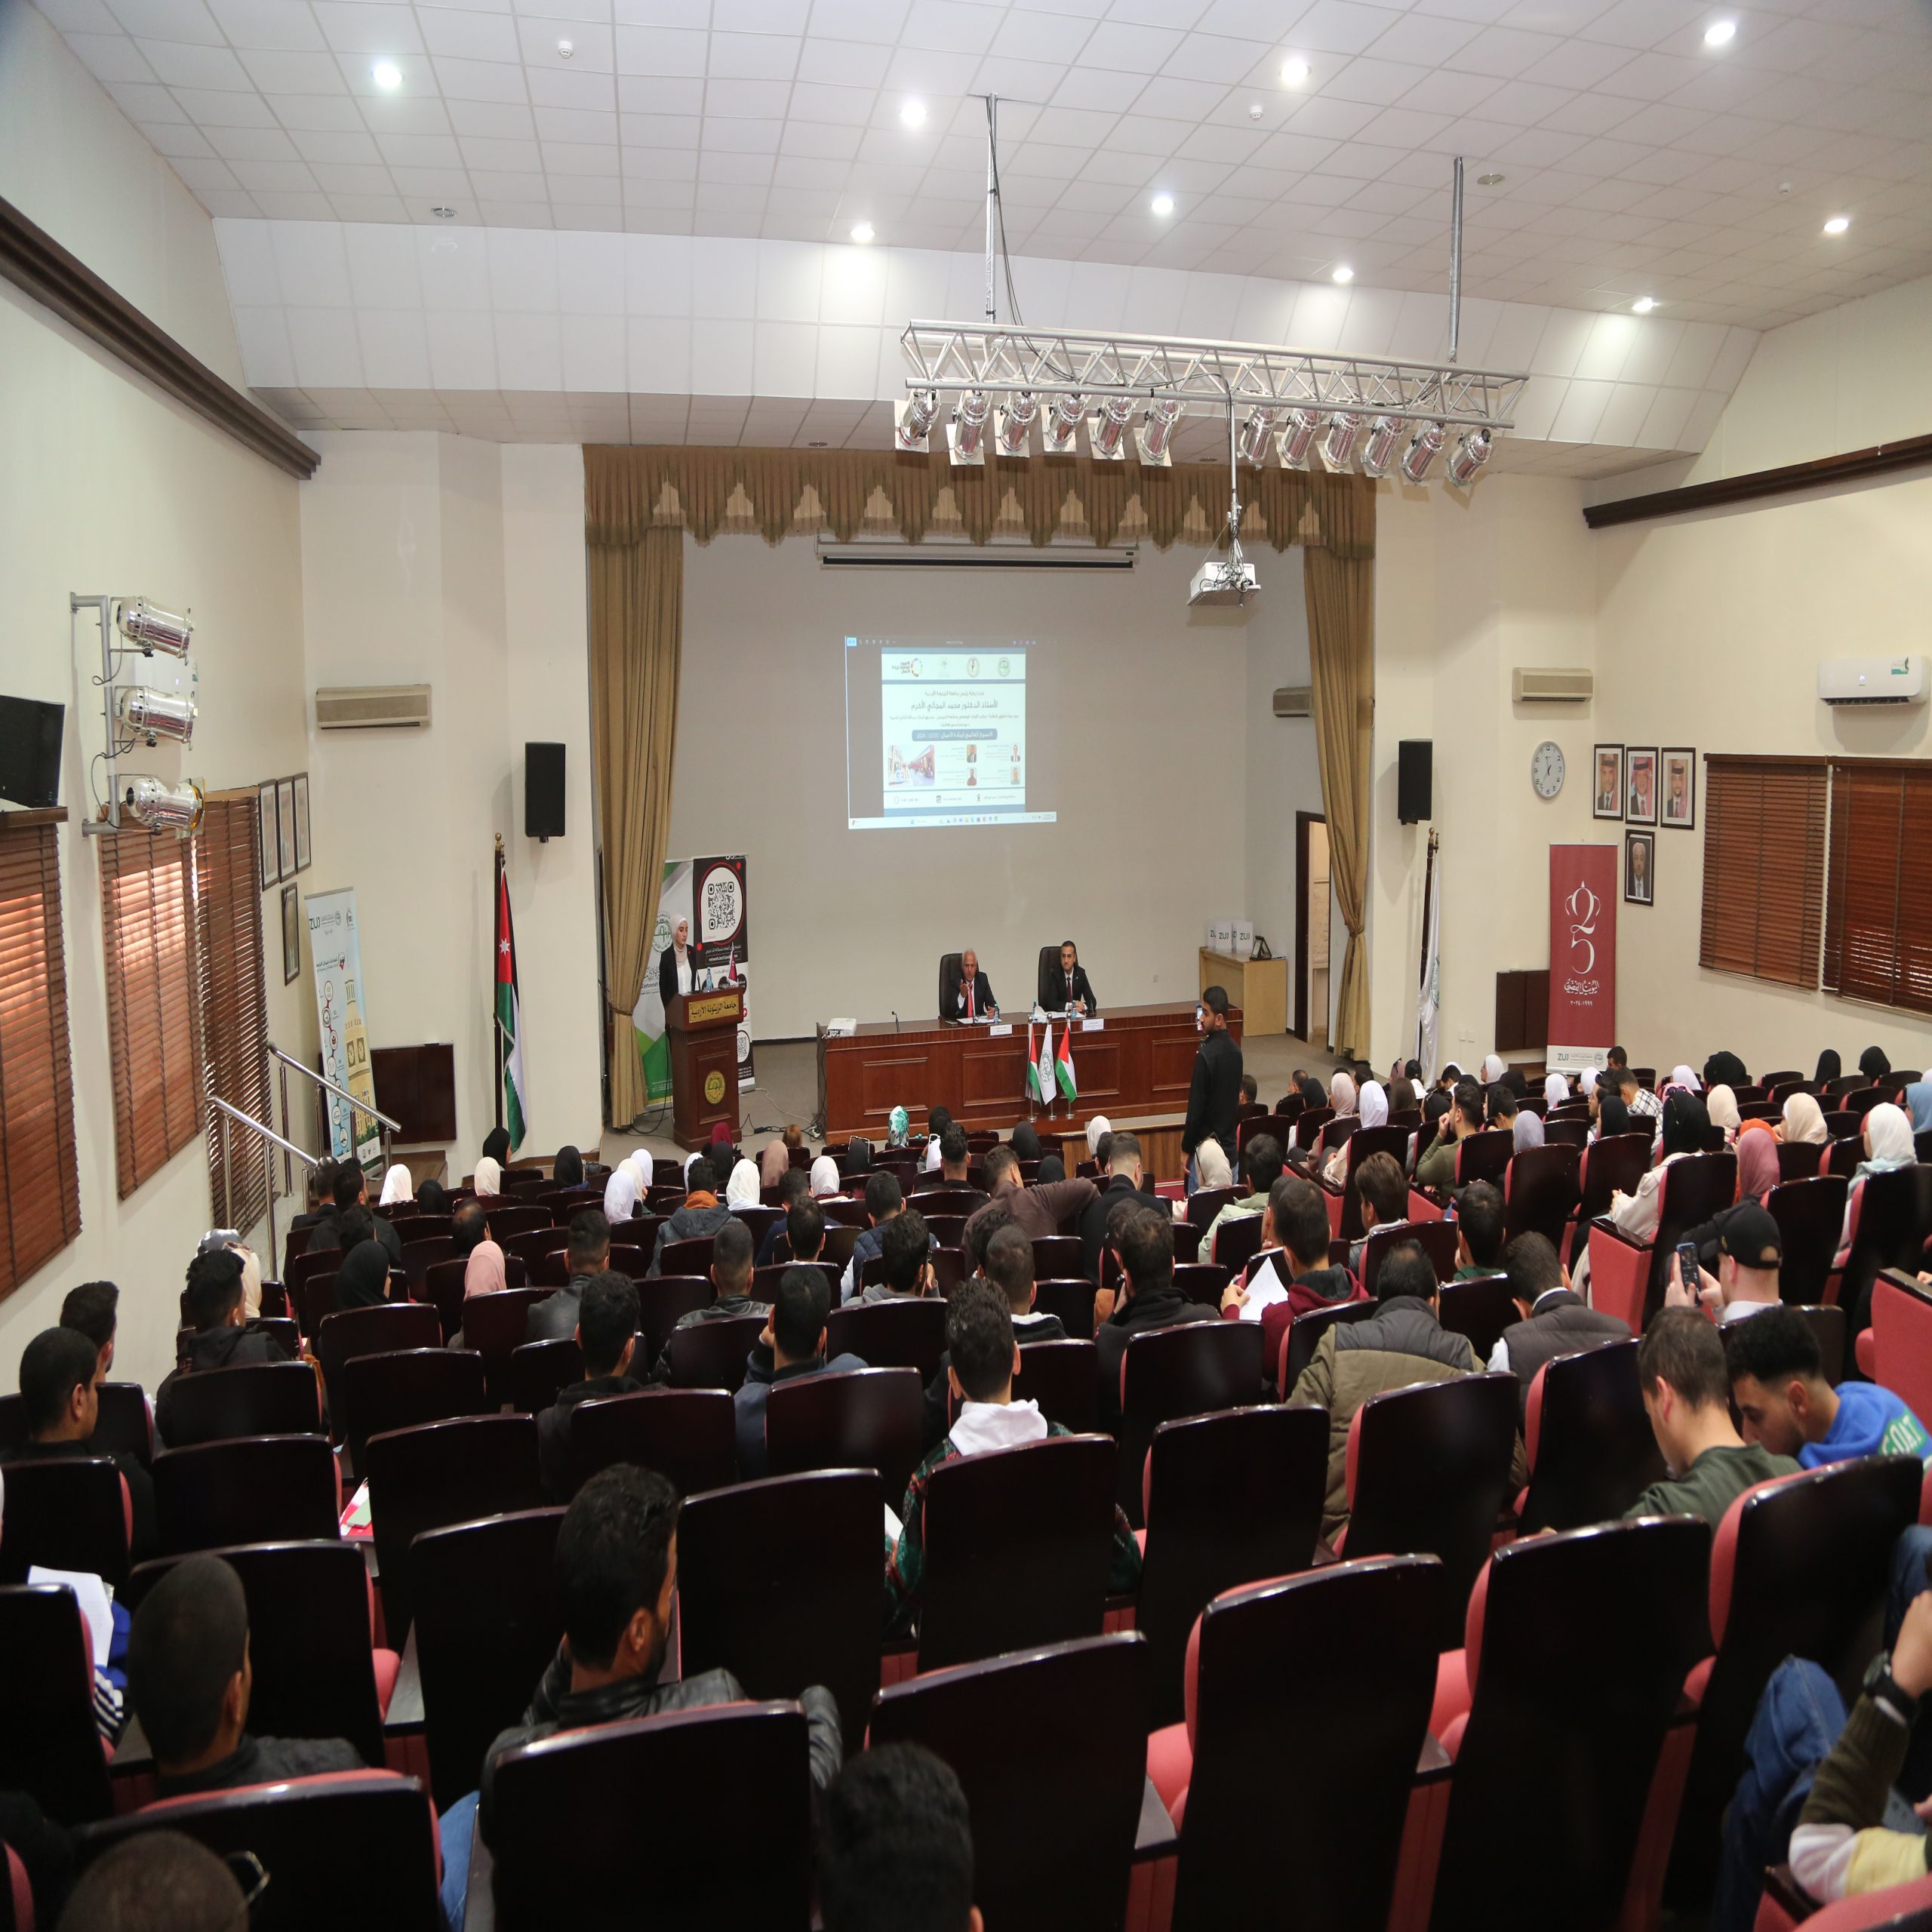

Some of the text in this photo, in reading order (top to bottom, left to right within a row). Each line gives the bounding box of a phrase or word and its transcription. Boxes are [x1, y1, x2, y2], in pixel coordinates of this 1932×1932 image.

[911, 699, 998, 712] الأستاذ الدكتور محمد المجالي الأكرم
[309, 917, 321, 930] ZUJ
[691, 1001, 737, 1018] جامعة الزيتونة الأردنية
[1557, 1053, 1569, 1061] ZUJ
